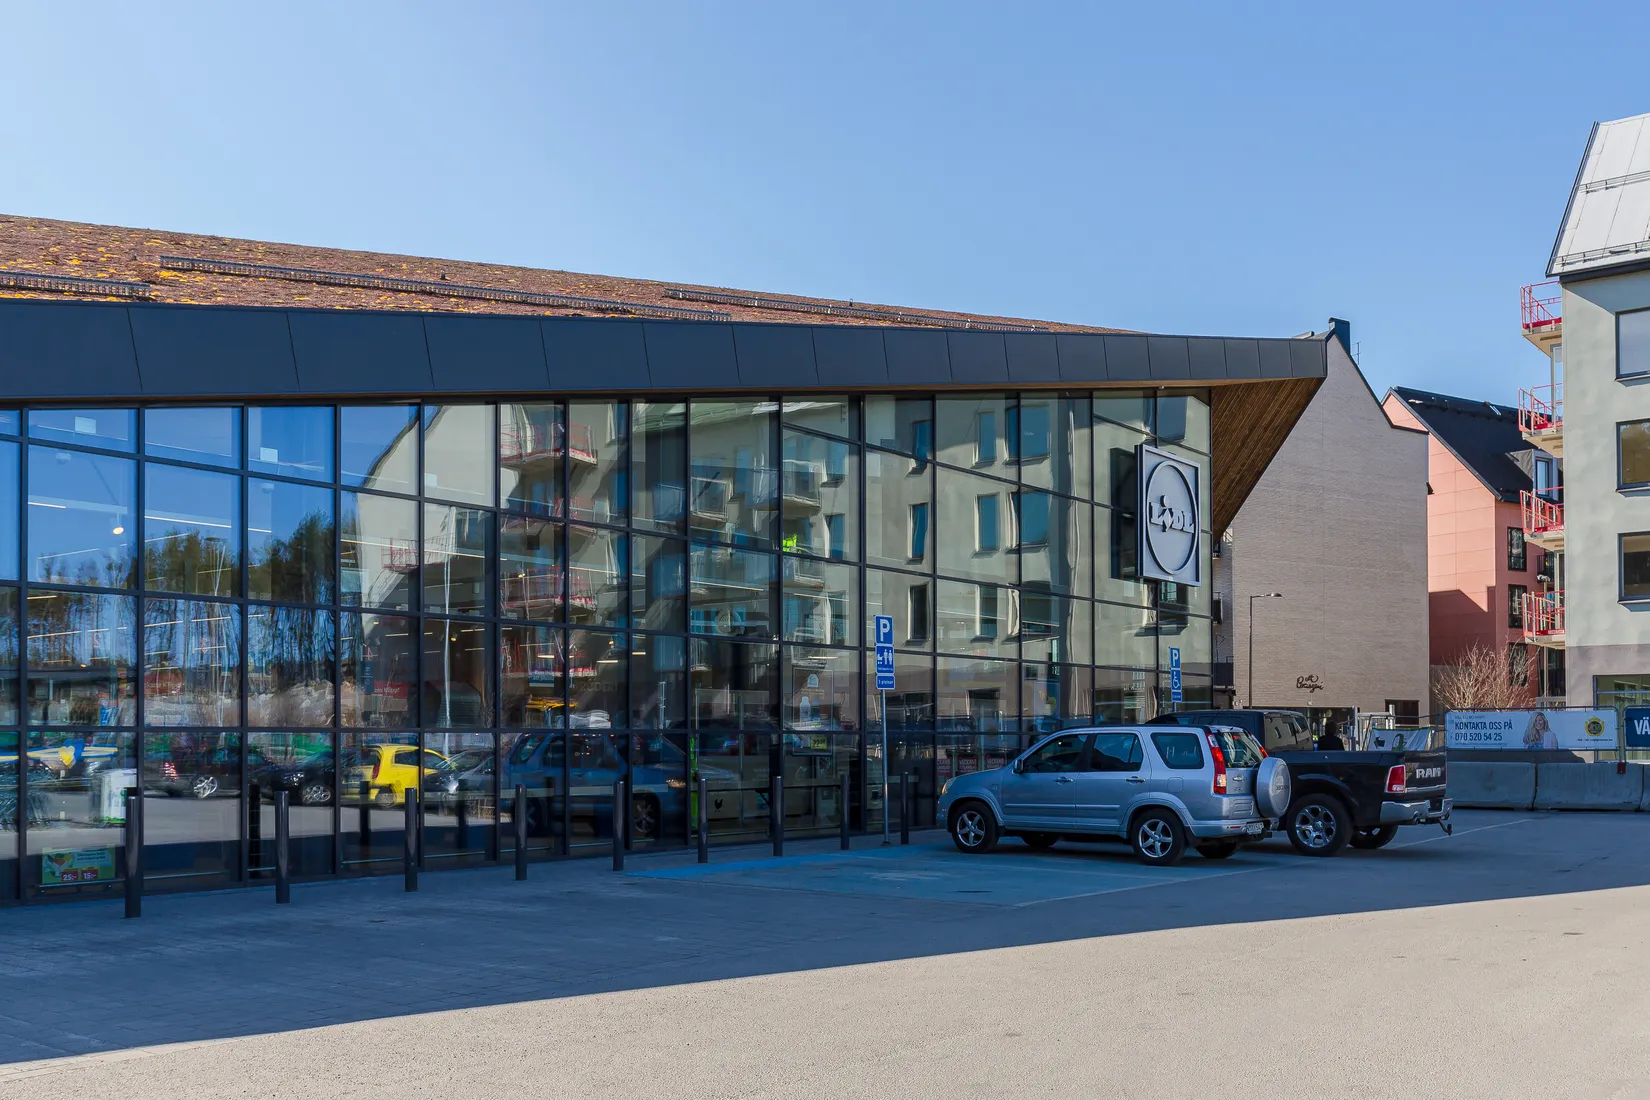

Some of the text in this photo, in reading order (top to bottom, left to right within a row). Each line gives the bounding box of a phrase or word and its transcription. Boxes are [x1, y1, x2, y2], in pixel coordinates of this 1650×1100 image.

[880, 619, 890, 641] P
[1172, 650, 1179, 666] P
[1455, 718, 1513, 730] KONTAKTA OSS PÅ
[1455, 733, 1502, 741] 070 520 54 25
[1416, 767, 1441, 779] RAM
